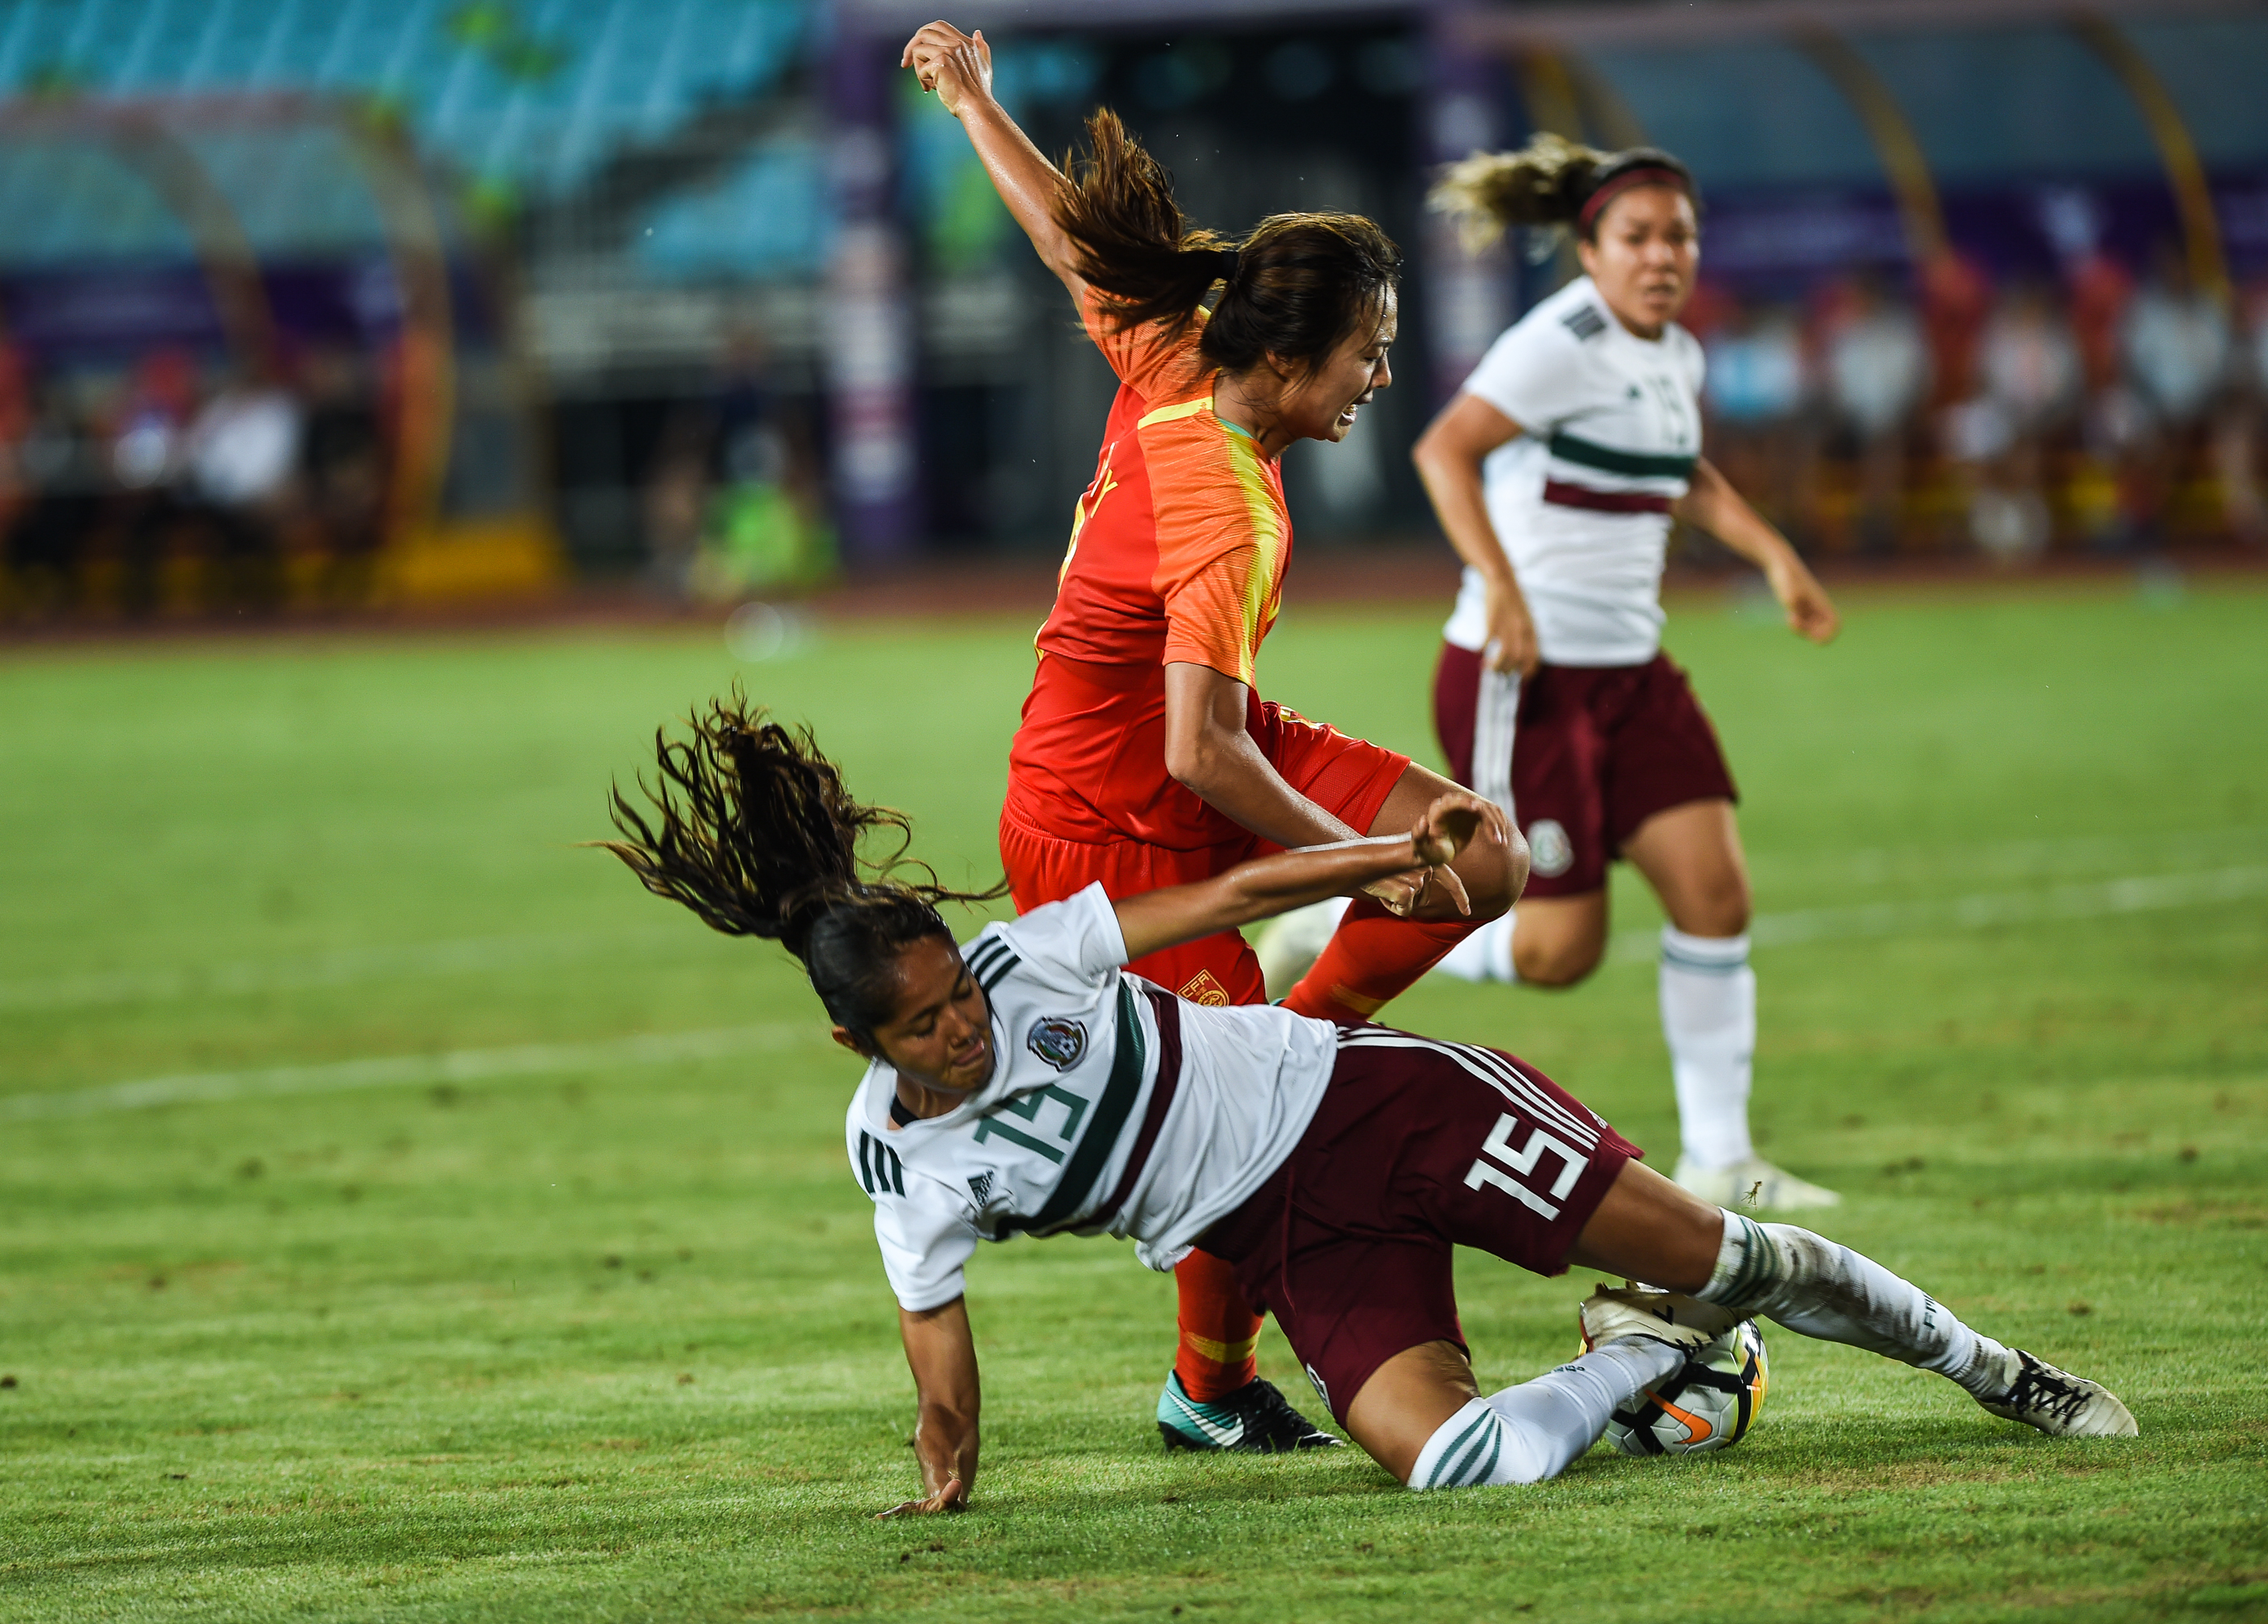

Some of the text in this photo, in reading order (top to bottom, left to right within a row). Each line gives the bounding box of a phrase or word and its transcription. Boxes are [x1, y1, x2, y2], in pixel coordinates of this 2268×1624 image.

[1182, 974, 1210, 998] CFA
[974, 1083, 1091, 1165] 15
[1463, 1112, 1590, 1221] 15
